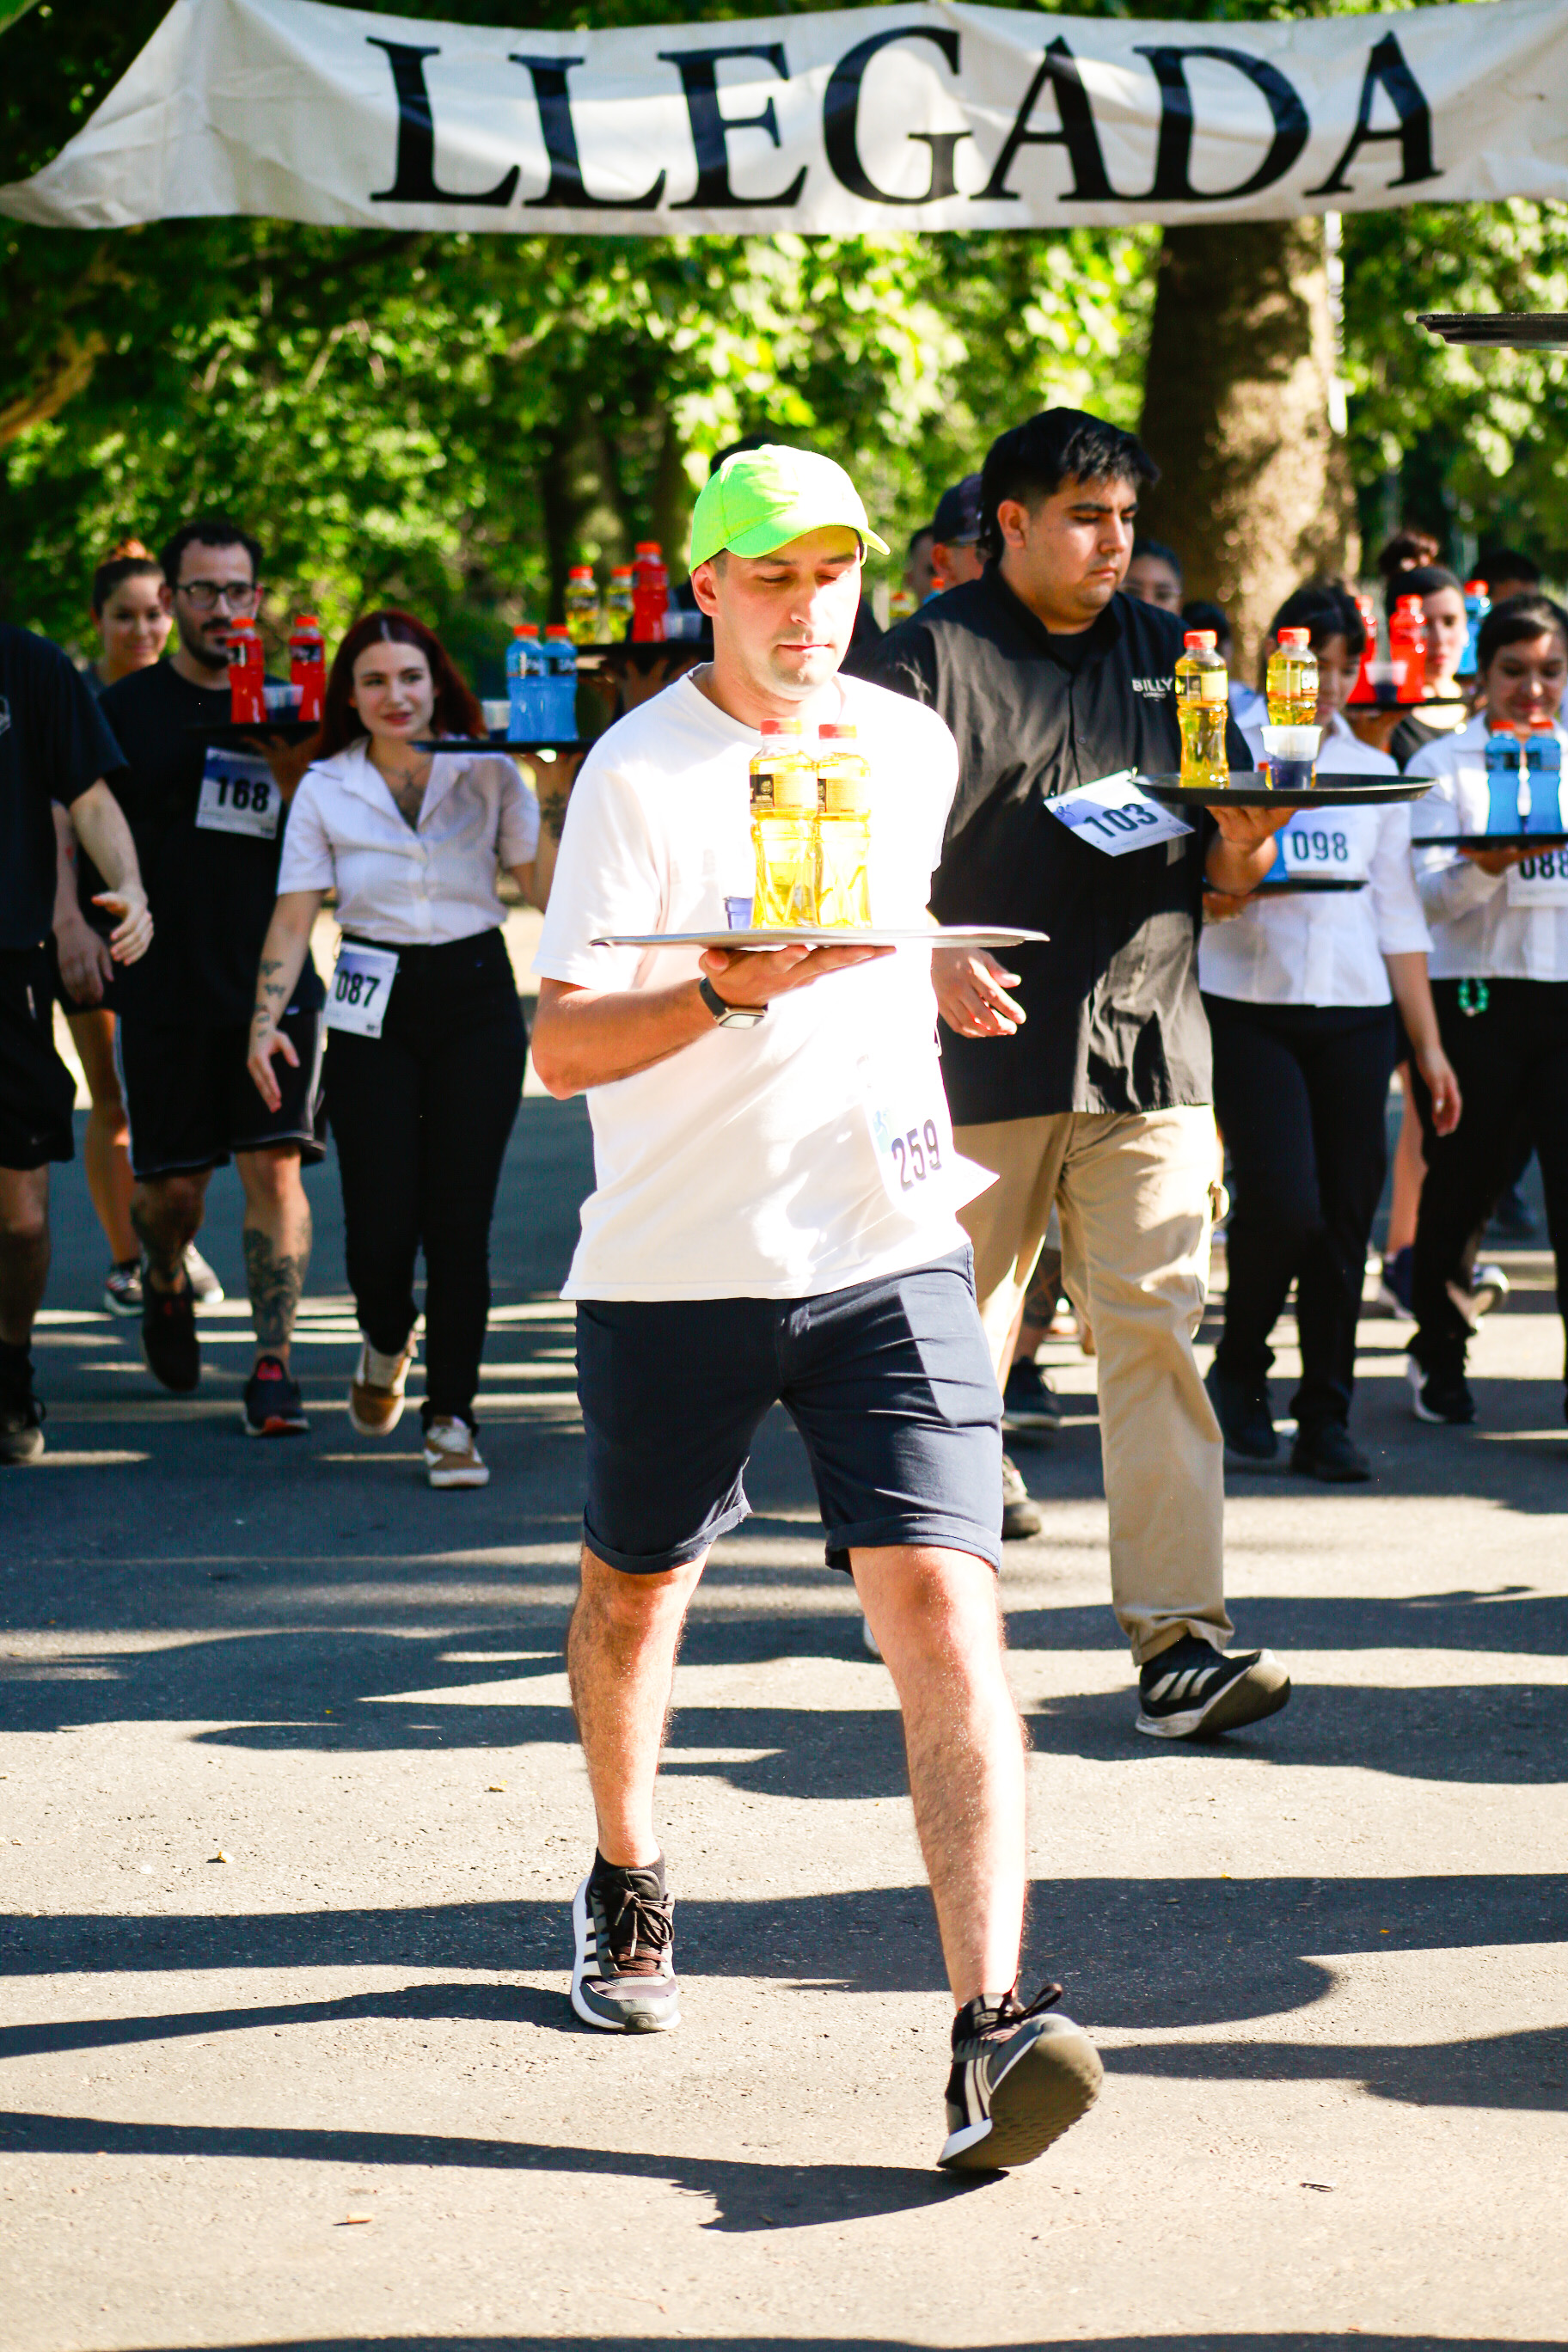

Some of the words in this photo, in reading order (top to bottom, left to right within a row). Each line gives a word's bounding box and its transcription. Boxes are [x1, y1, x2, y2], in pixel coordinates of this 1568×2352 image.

[365, 25, 1445, 209] LLEGADA
[1131, 676, 1173, 692] BILLY
[217, 775, 270, 813] 168
[1083, 803, 1159, 838] 103
[1292, 830, 1348, 861] 098
[335, 970, 381, 1008] 087
[890, 1118, 942, 1192] 259
